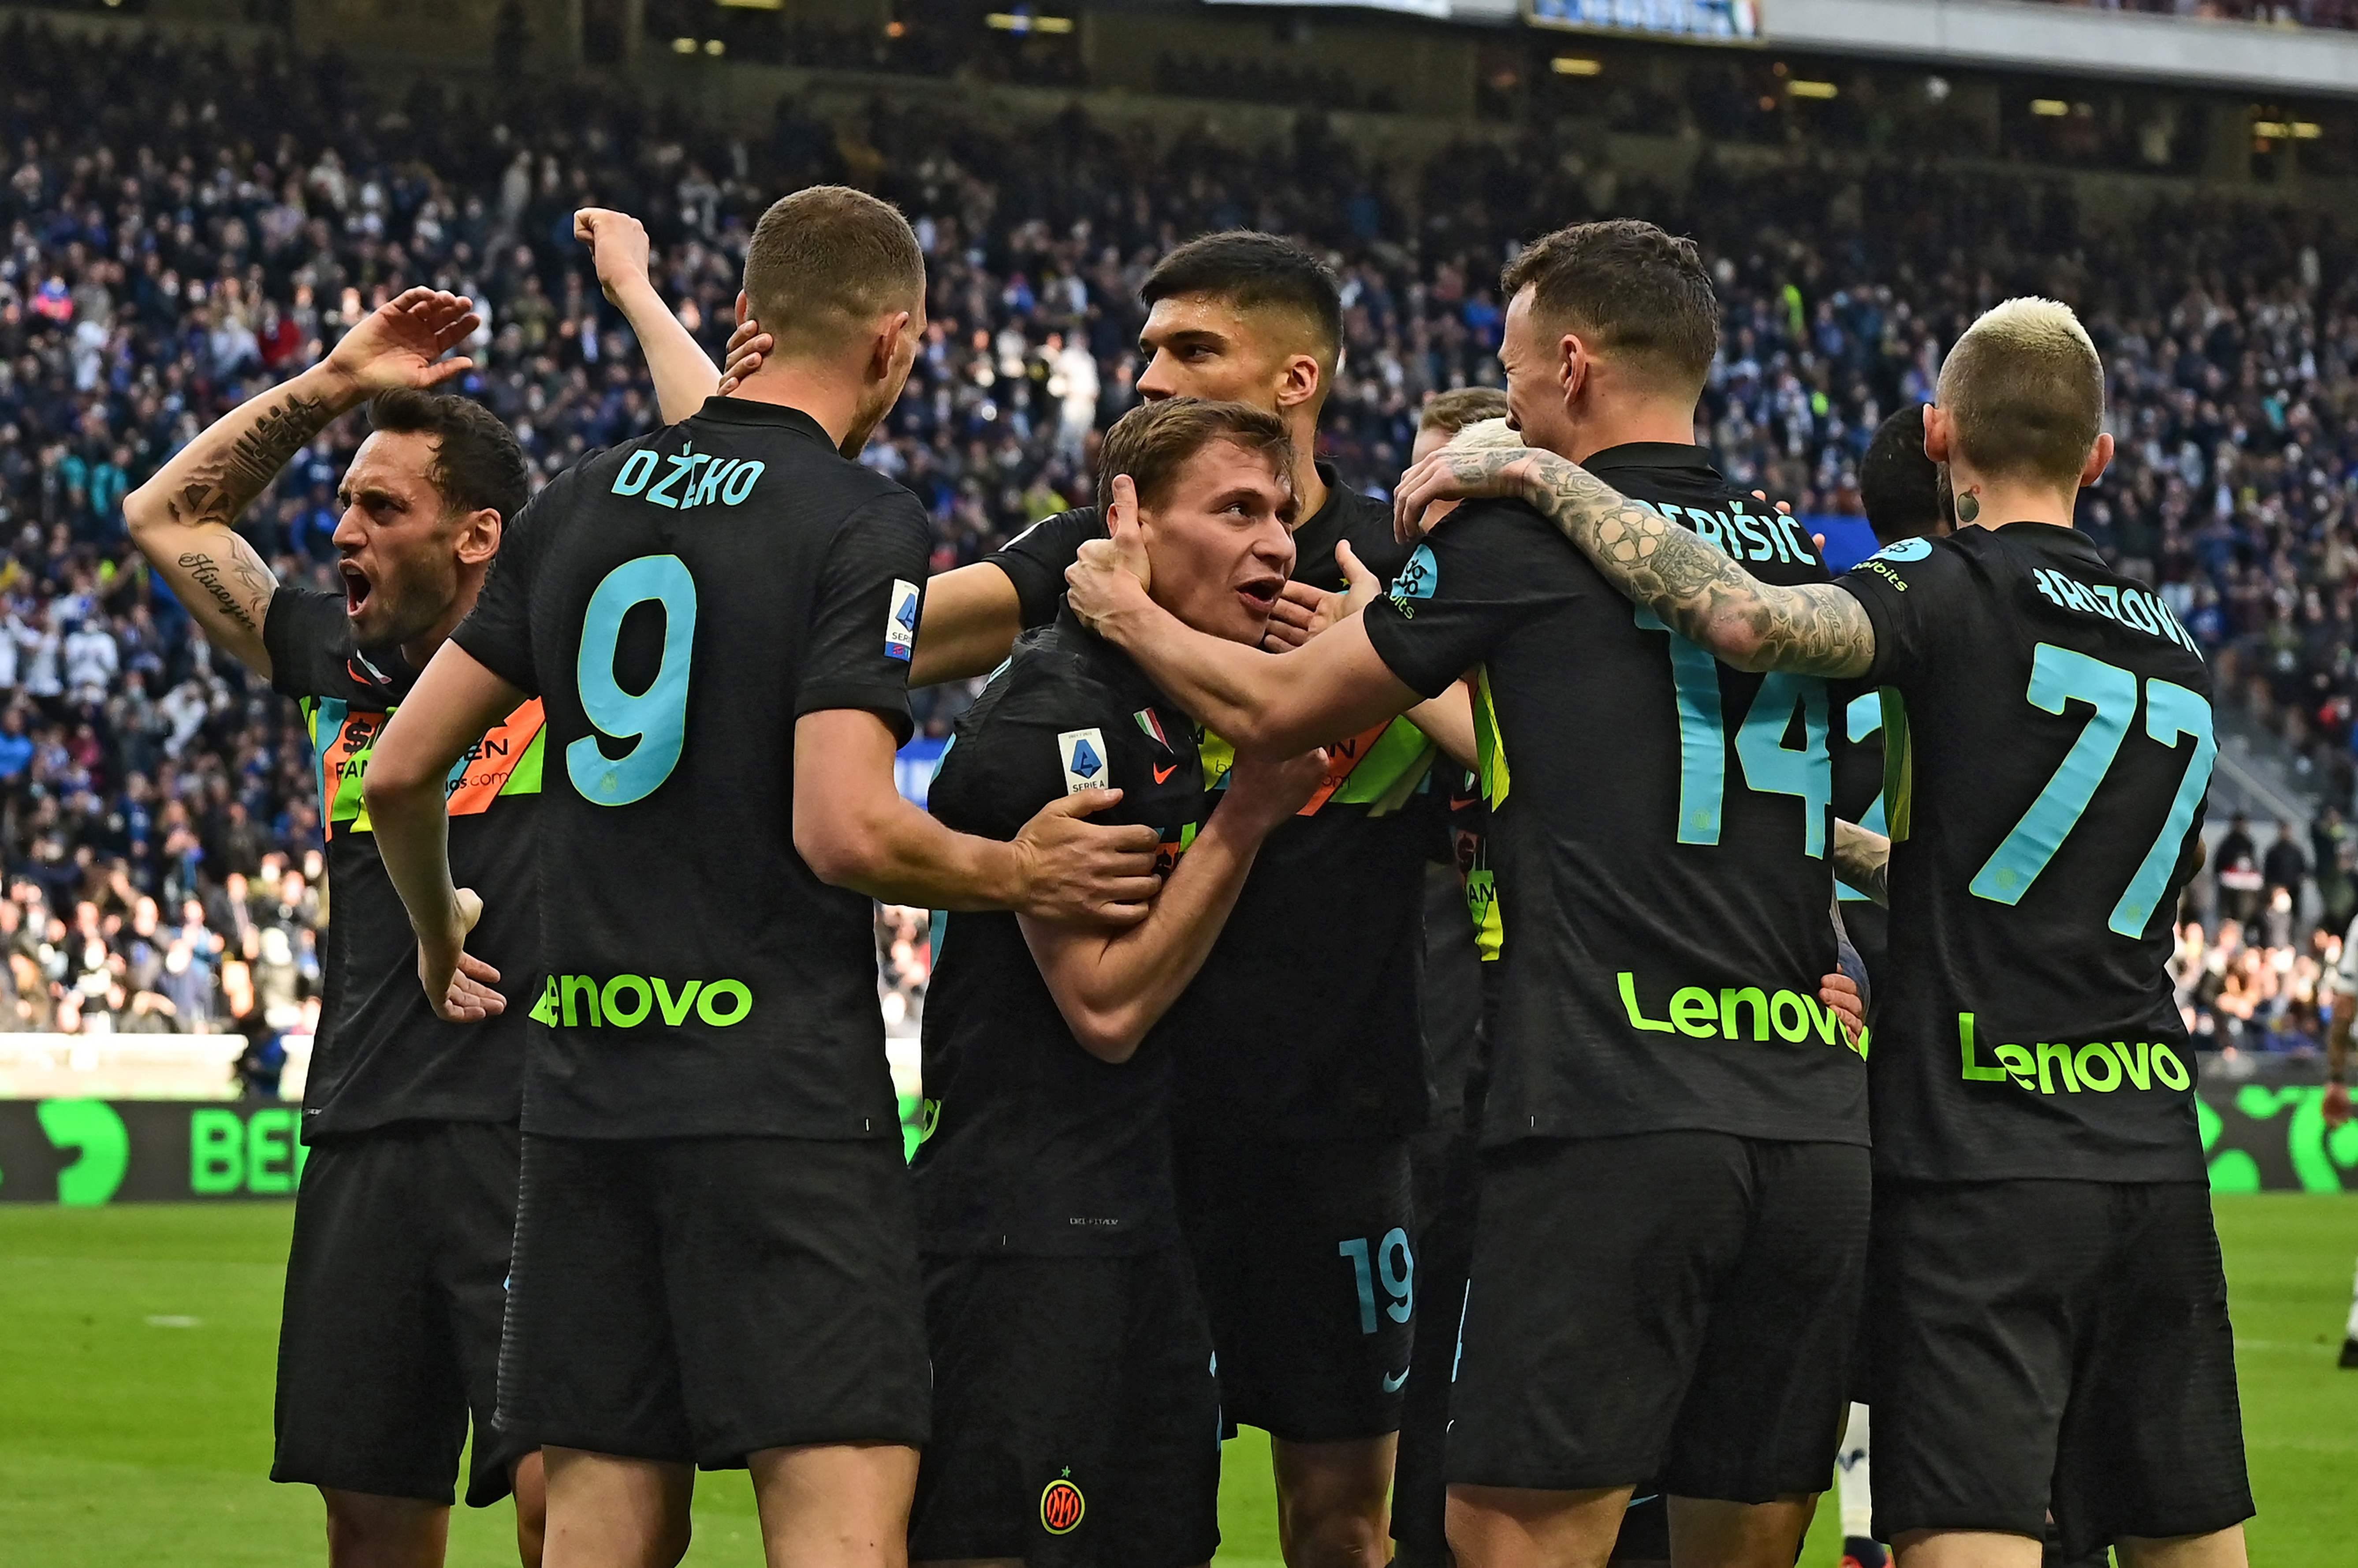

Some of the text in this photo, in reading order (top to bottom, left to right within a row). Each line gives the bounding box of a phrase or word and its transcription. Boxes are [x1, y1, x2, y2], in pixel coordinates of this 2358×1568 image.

[178, 552, 256, 631] Hüseyin
[566, 554, 697, 807] 9
[1634, 602, 1832, 860] 14
[1072, 779, 1106, 792] SERIE A
[1969, 642, 2218, 940] 77
[1958, 1012, 2191, 1094] Lenovo
[1339, 1227, 1414, 1334] 19
